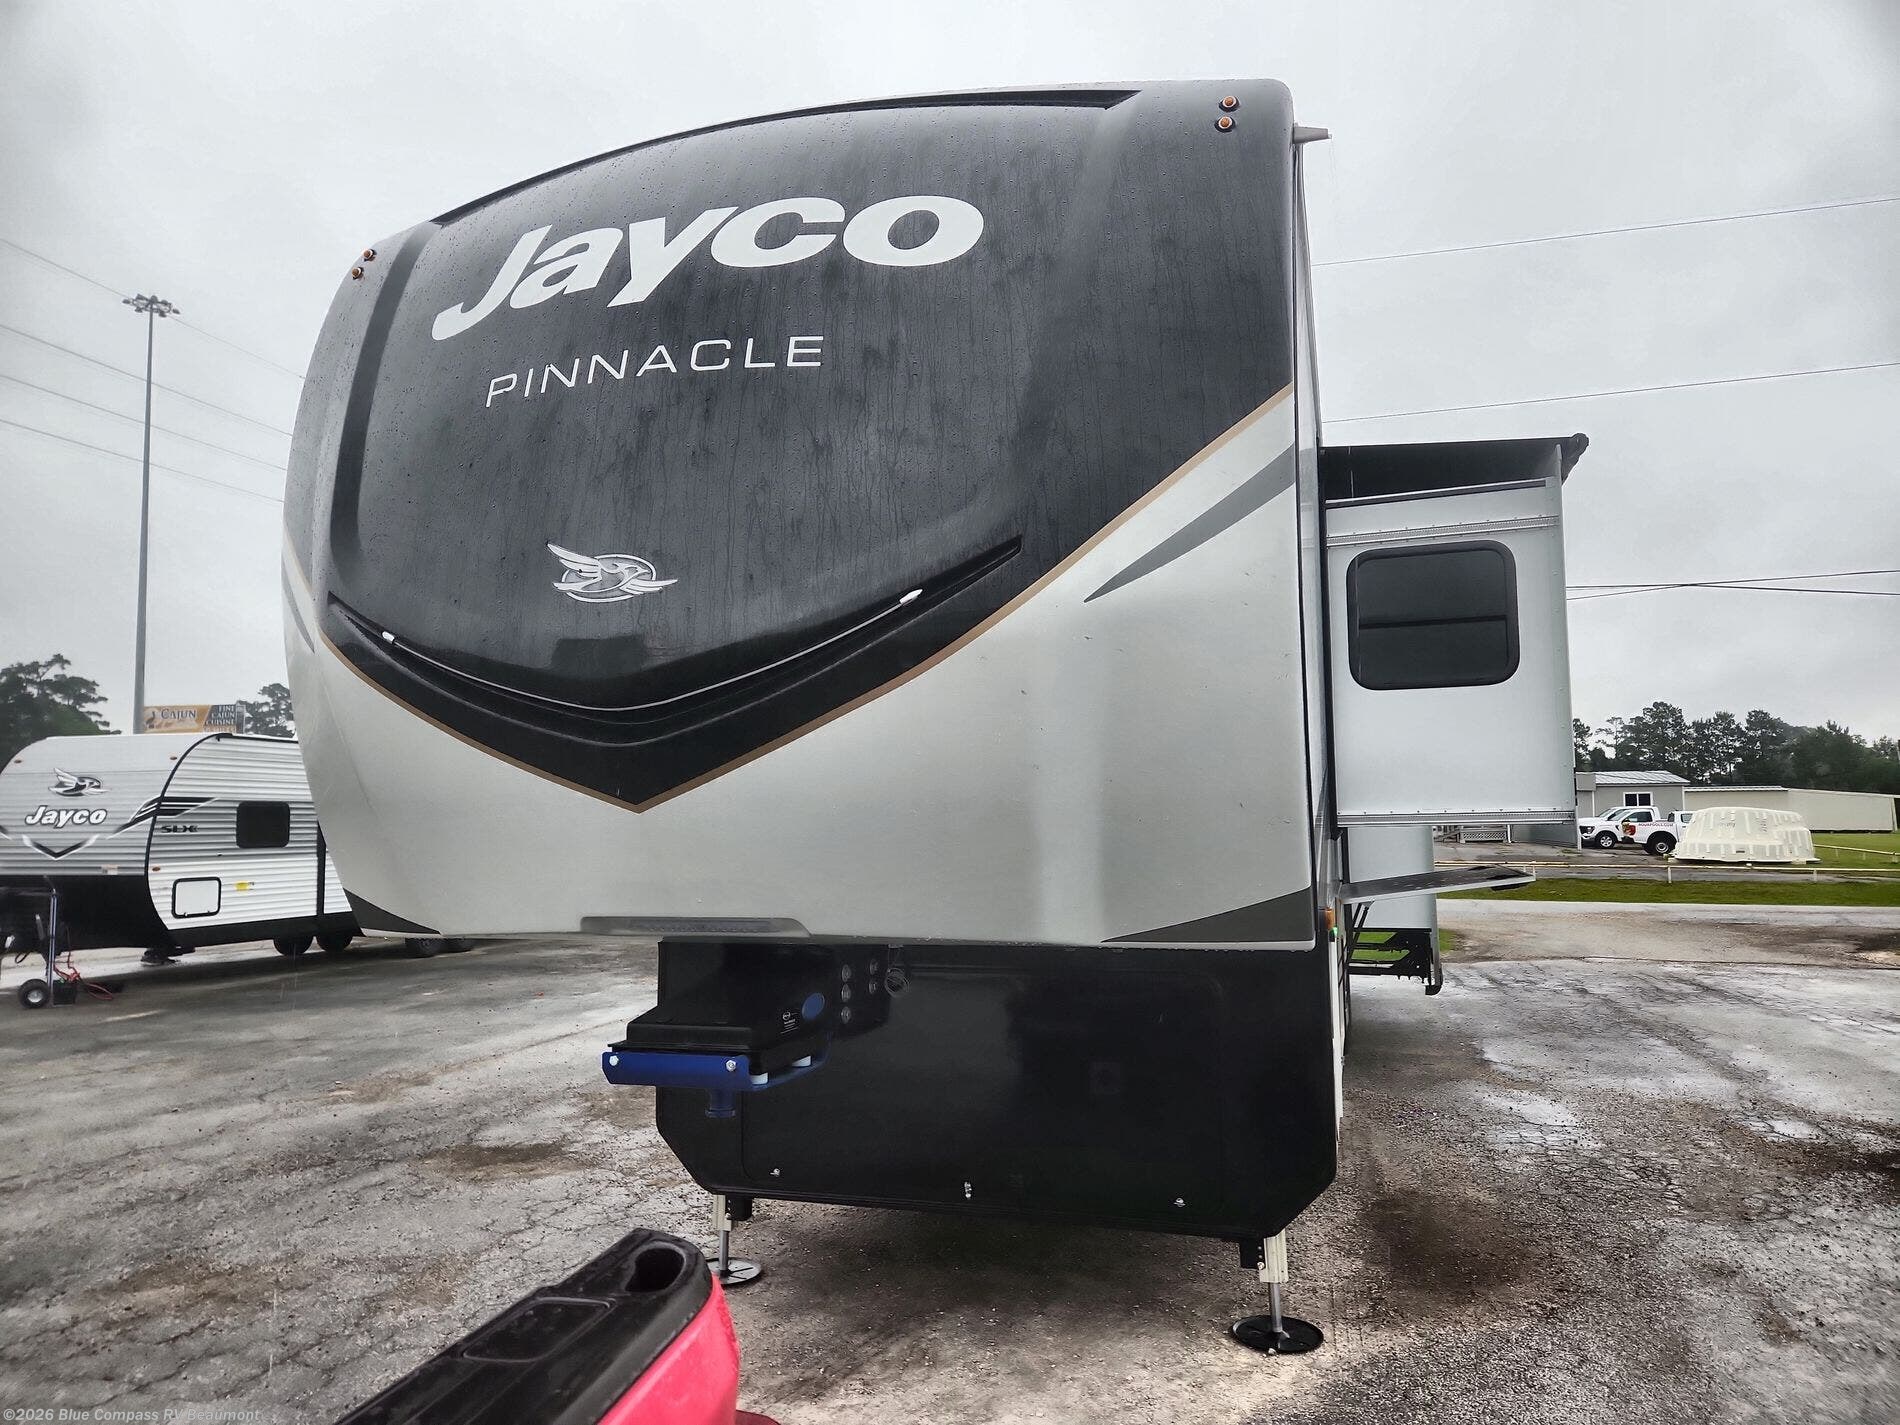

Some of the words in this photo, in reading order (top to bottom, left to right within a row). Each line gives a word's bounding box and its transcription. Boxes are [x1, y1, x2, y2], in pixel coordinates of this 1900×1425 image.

[431, 195, 984, 341] Jayco
[485, 335, 824, 408] PINNACLE
[161, 708, 197, 720] CAJUN
[25, 805, 107, 829] Jayco
